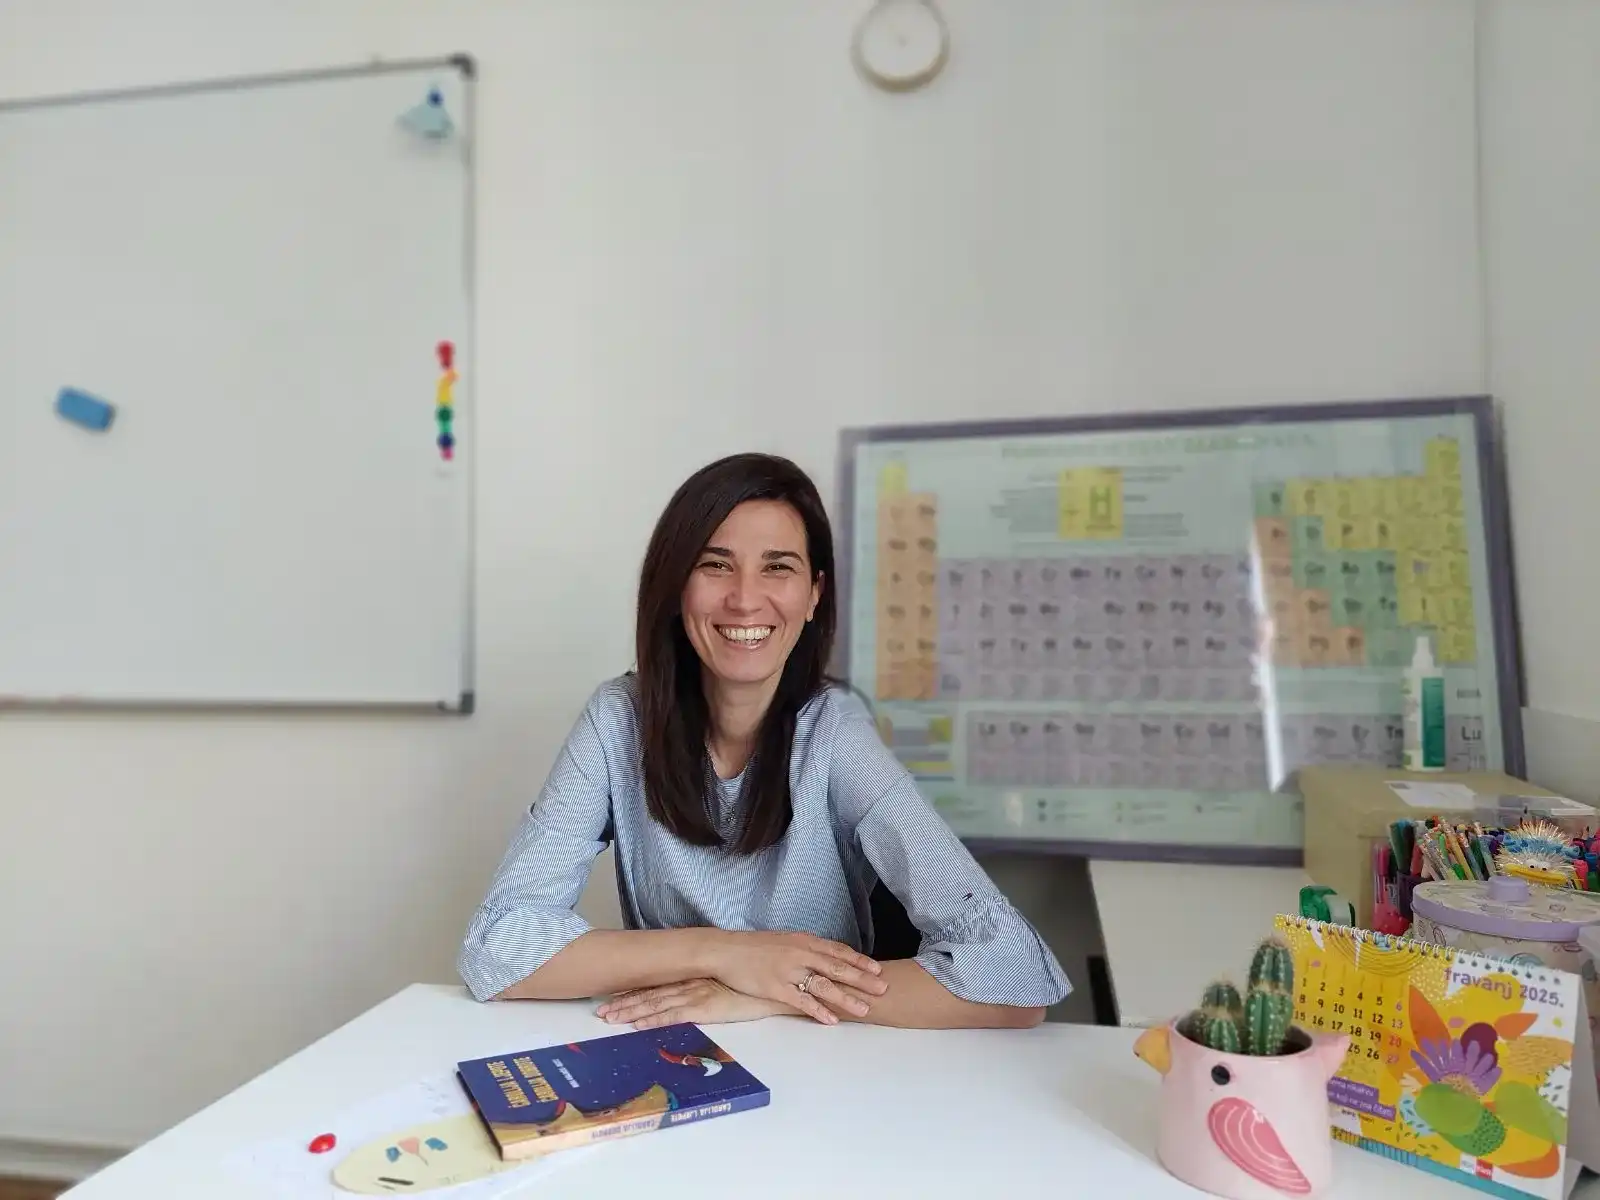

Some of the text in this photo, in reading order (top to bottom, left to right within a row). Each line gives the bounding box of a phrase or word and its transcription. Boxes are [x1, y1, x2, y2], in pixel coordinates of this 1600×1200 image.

[1088, 486, 1111, 517] H
[1461, 725, 1482, 741] Lu
[1302, 978, 1402, 1011] 1 2 3 4 5 6
[1519, 984, 1565, 1008] 2025.
[1299, 994, 1403, 1029] 8 9 10 11 12 13
[1295, 1010, 1402, 1047] 15 16 17 18 19 20
[1367, 1048, 1380, 1060] 26
